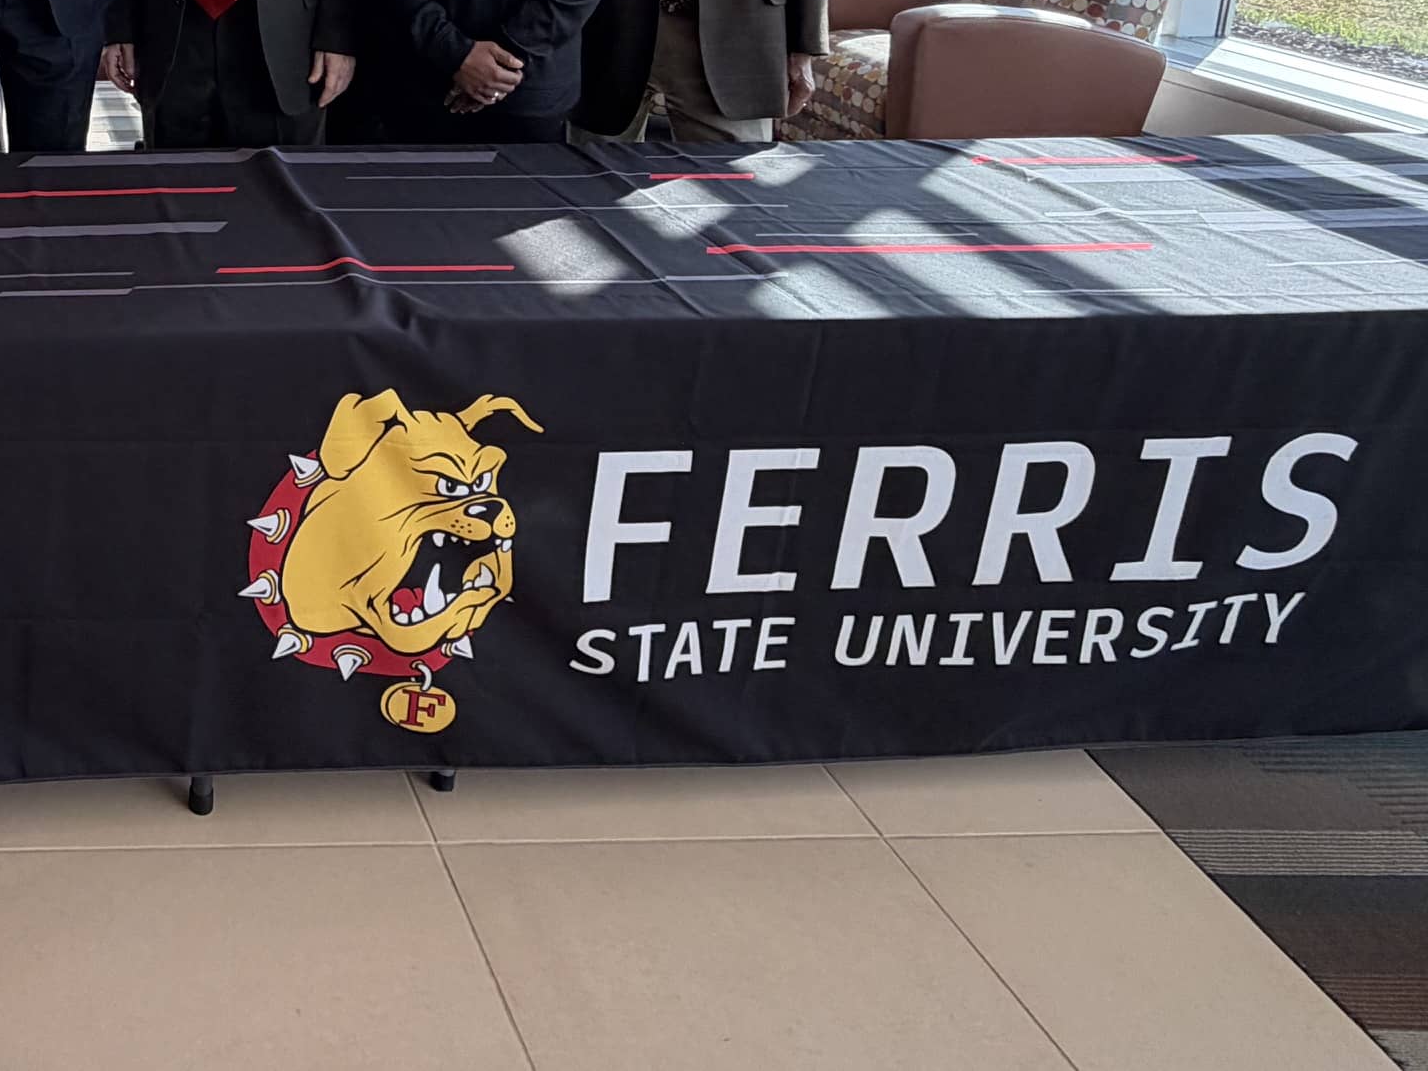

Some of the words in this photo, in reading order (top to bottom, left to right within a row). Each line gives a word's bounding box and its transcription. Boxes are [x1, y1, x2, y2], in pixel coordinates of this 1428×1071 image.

[583, 432, 1359, 603] FERRIS
[569, 596, 796, 682] STATE
[834, 592, 1306, 667] UNIVERSITY
[398, 688, 447, 727] F
